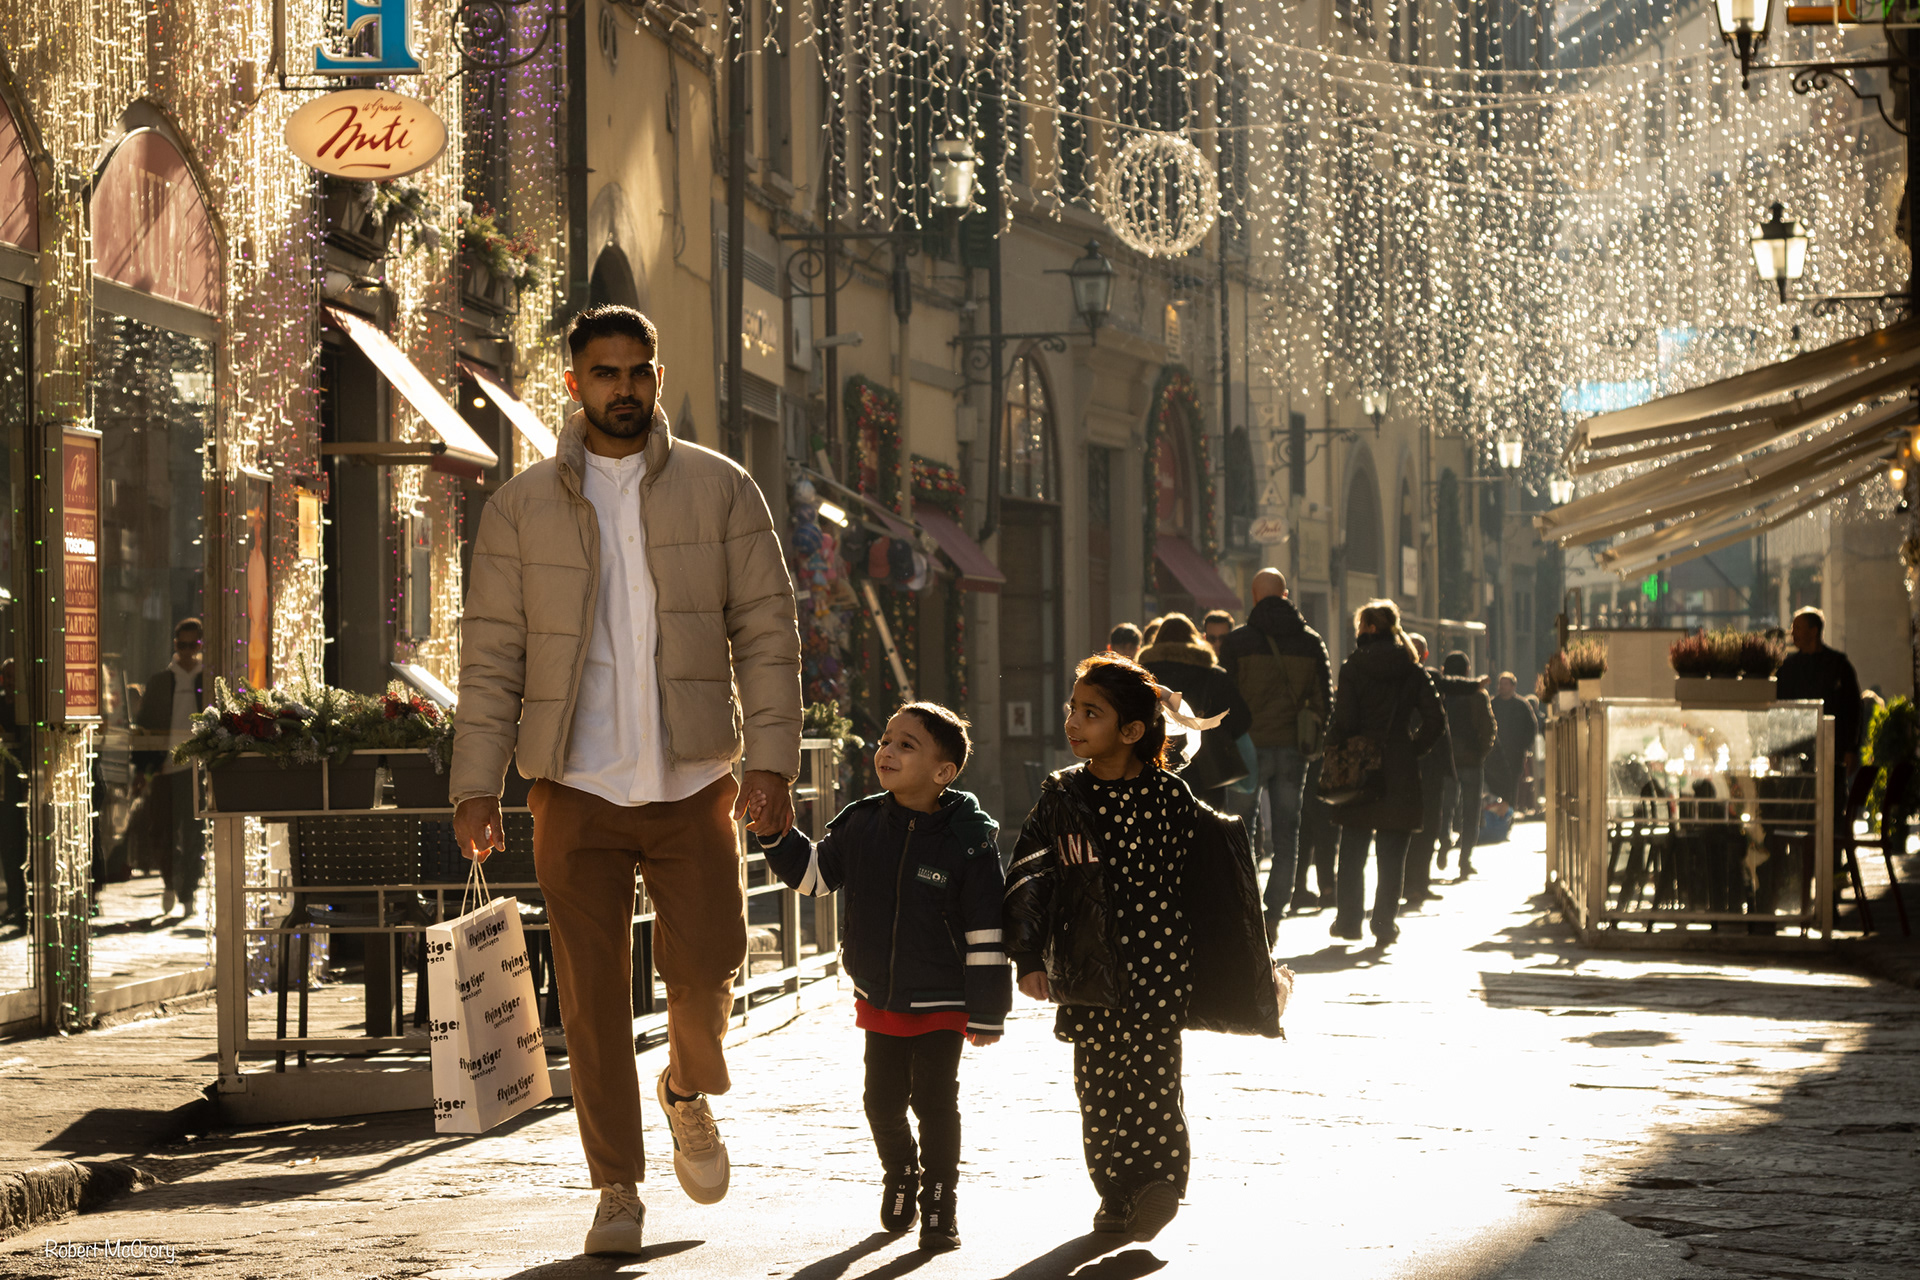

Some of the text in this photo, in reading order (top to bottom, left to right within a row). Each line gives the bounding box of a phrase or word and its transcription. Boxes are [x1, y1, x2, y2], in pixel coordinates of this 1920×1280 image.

[65, 563, 95, 591] BISTECCA
[65, 615, 96, 634] TARTUFO
[469, 920, 505, 946] flying tiger
[477, 937, 499, 952] copenhagen
[501, 956, 523, 972] flying
[470, 971, 485, 987] tiger
[485, 997, 520, 1023] flying tiger
[494, 1014, 515, 1029] copenhagen
[517, 1032, 537, 1049] flying
[459, 1048, 502, 1073] flying tiger
[470, 1065, 496, 1080] copenhagen
[497, 1073, 535, 1101] flying tiger
[508, 1090, 530, 1106] copenhagen
